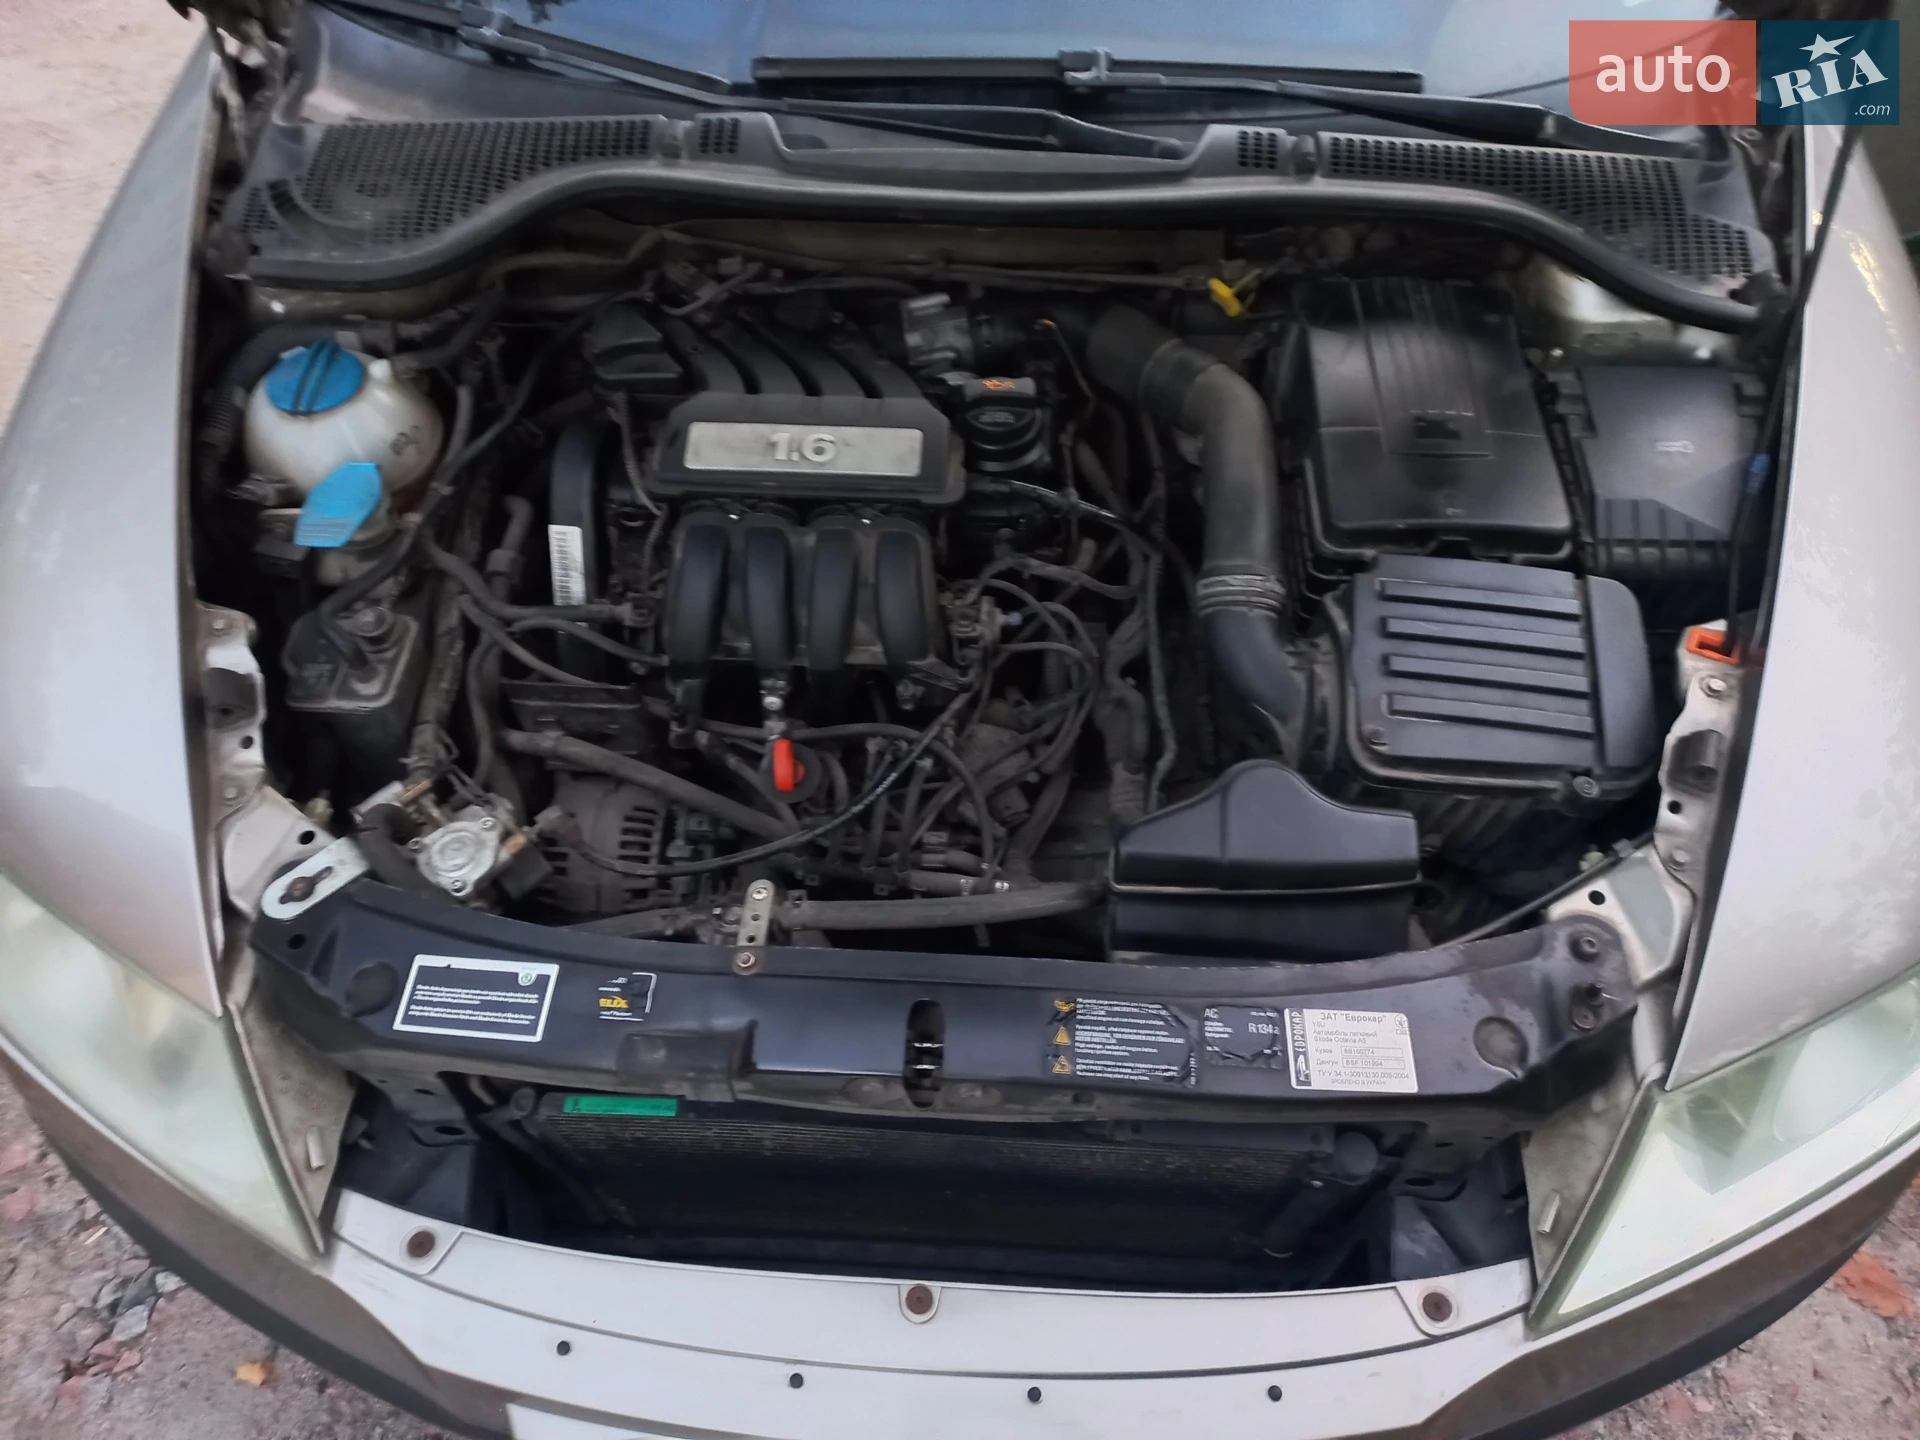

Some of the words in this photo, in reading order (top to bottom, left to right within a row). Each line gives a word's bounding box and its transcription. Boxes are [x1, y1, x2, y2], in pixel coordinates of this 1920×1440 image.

[771, 431, 837, 462] 1.6
[1204, 1008, 1219, 1019] AC
[1320, 1012, 1338, 1021] ЗАТ
[1340, 1013, 1386, 1024] "Еврокар"
[1334, 1036, 1357, 1044] Octavia
[1315, 1047, 1333, 1055] Кузов
[1316, 1059, 1339, 1067] Двигун
